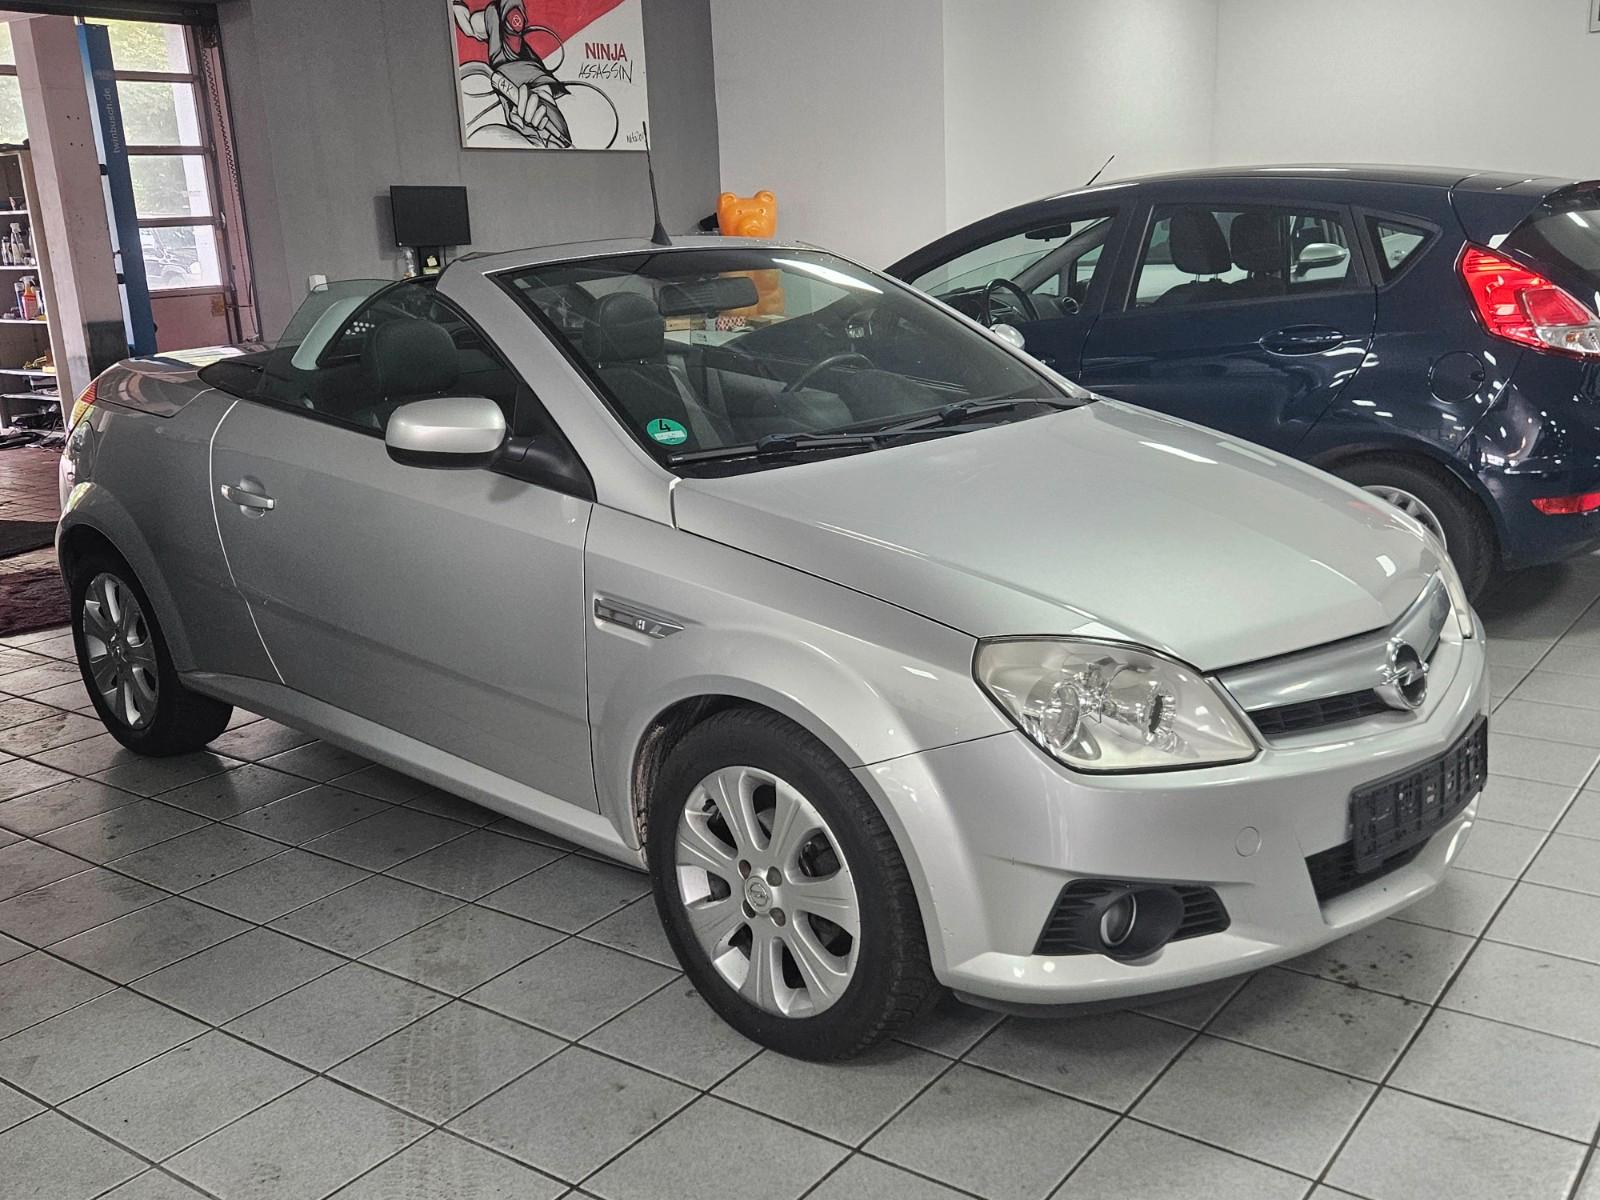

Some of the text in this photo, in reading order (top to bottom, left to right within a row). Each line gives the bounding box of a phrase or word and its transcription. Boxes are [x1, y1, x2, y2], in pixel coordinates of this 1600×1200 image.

[585, 42, 628, 62] NINJA
[578, 60, 633, 84] ASSASSIN
[104, 87, 121, 154] twinbusch.de
[659, 419, 671, 431] 4
